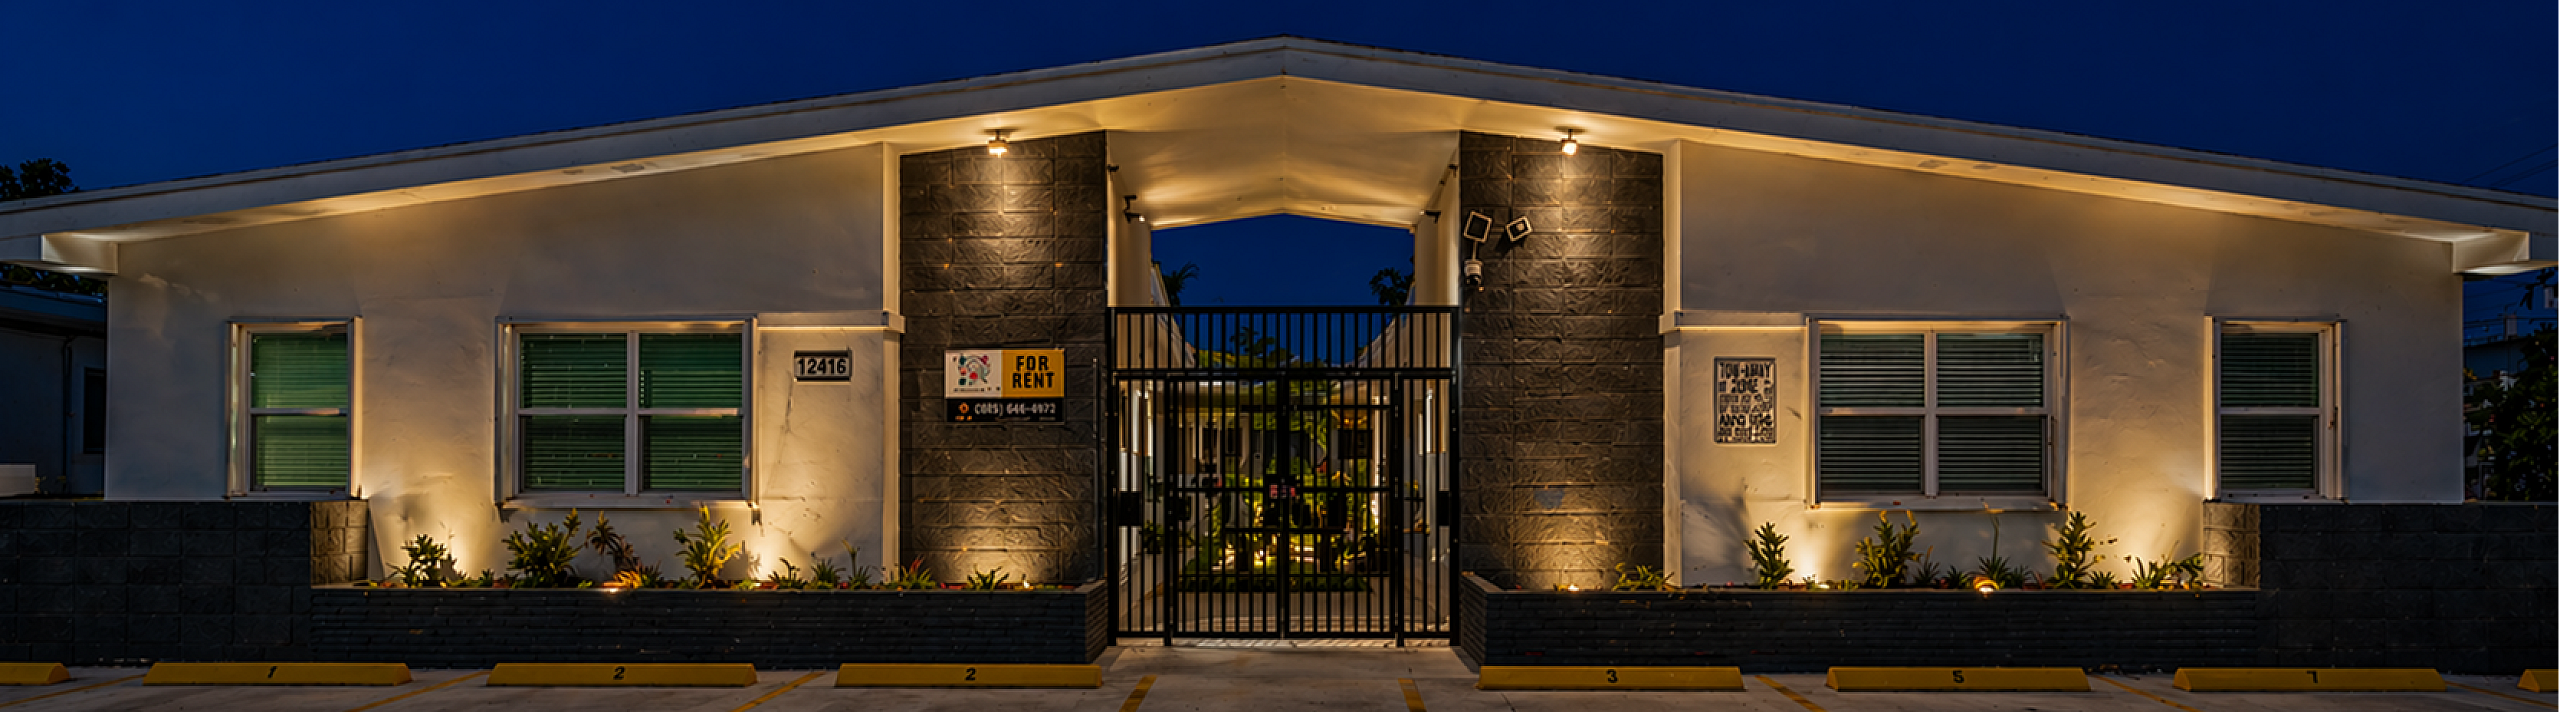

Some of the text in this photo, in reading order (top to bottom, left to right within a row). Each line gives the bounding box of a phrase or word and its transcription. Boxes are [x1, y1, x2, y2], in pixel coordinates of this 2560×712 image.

[797, 357, 847, 375] 12416
[1016, 355, 1049, 371] FOR
[1012, 372, 1055, 389] RENT
[612, 665, 625, 681] 2
[965, 667, 976, 681] 2
[1606, 668, 1618, 684] 3
[1952, 670, 1965, 684] 5
